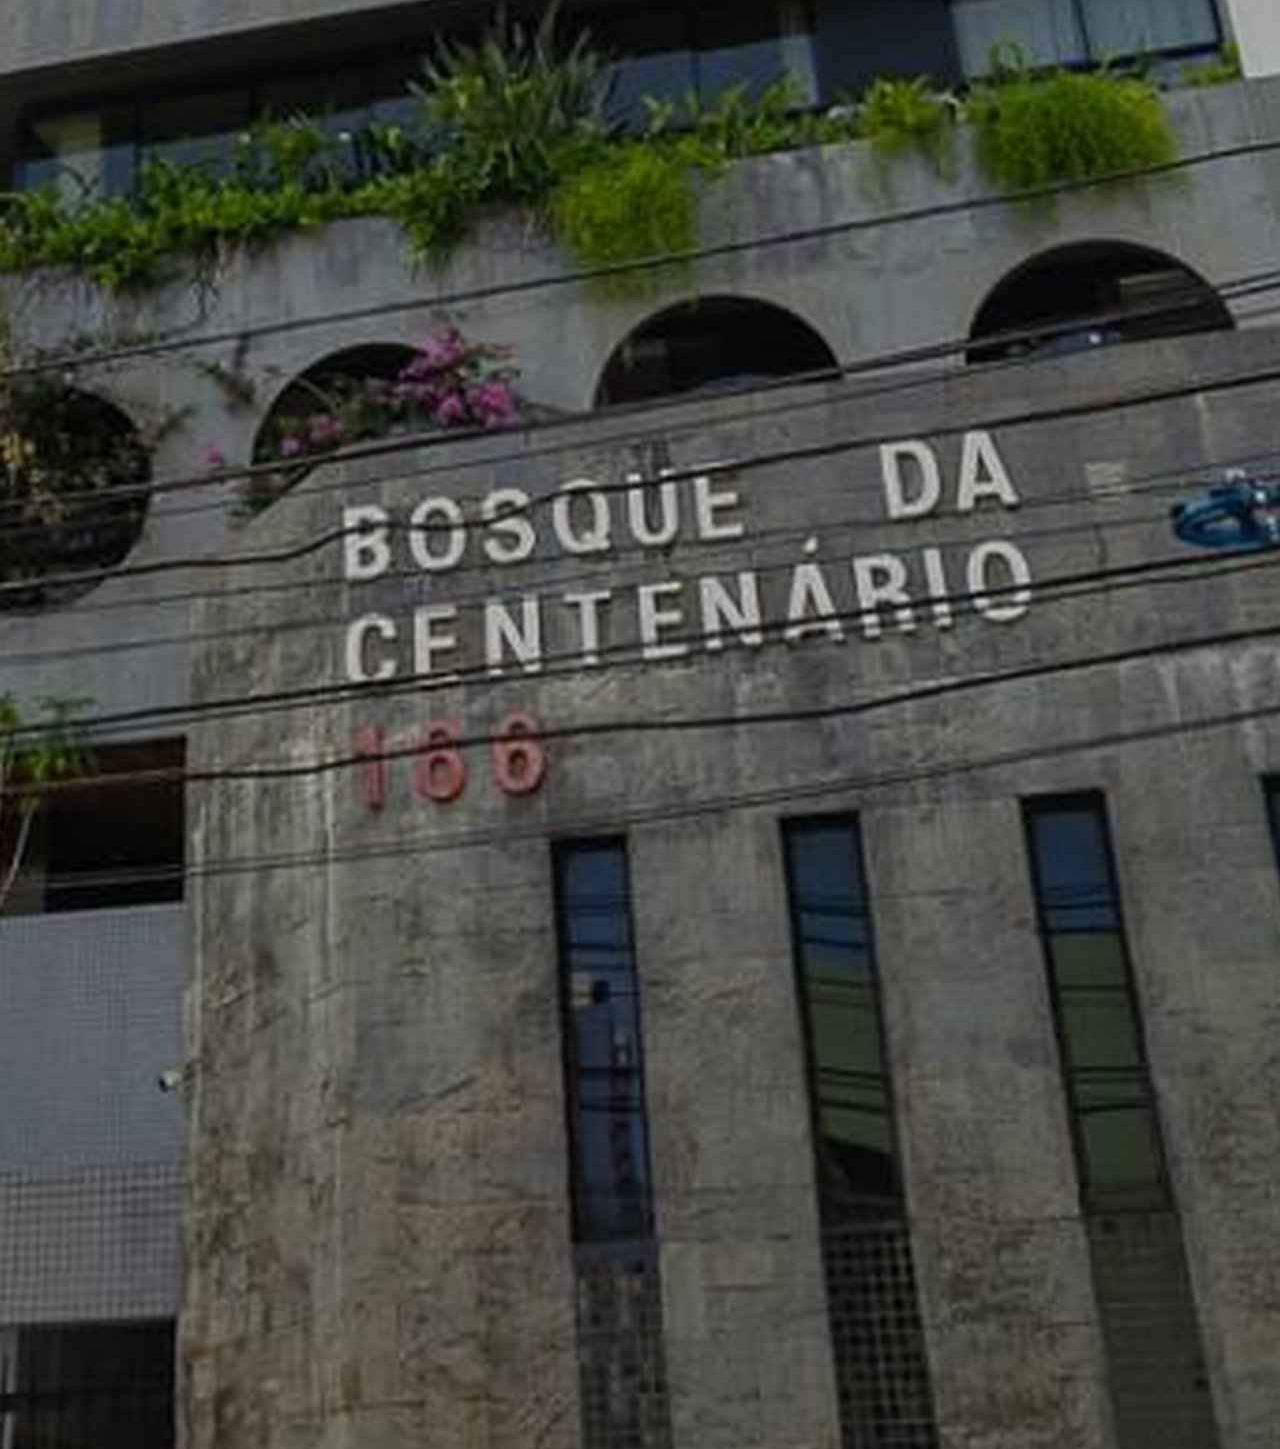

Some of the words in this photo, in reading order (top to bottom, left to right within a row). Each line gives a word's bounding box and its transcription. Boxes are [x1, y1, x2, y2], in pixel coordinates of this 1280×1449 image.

[342, 460, 744, 581] BOSQUE
[879, 429, 1020, 519] DA
[345, 536, 1032, 686] CENTENÁRIO
